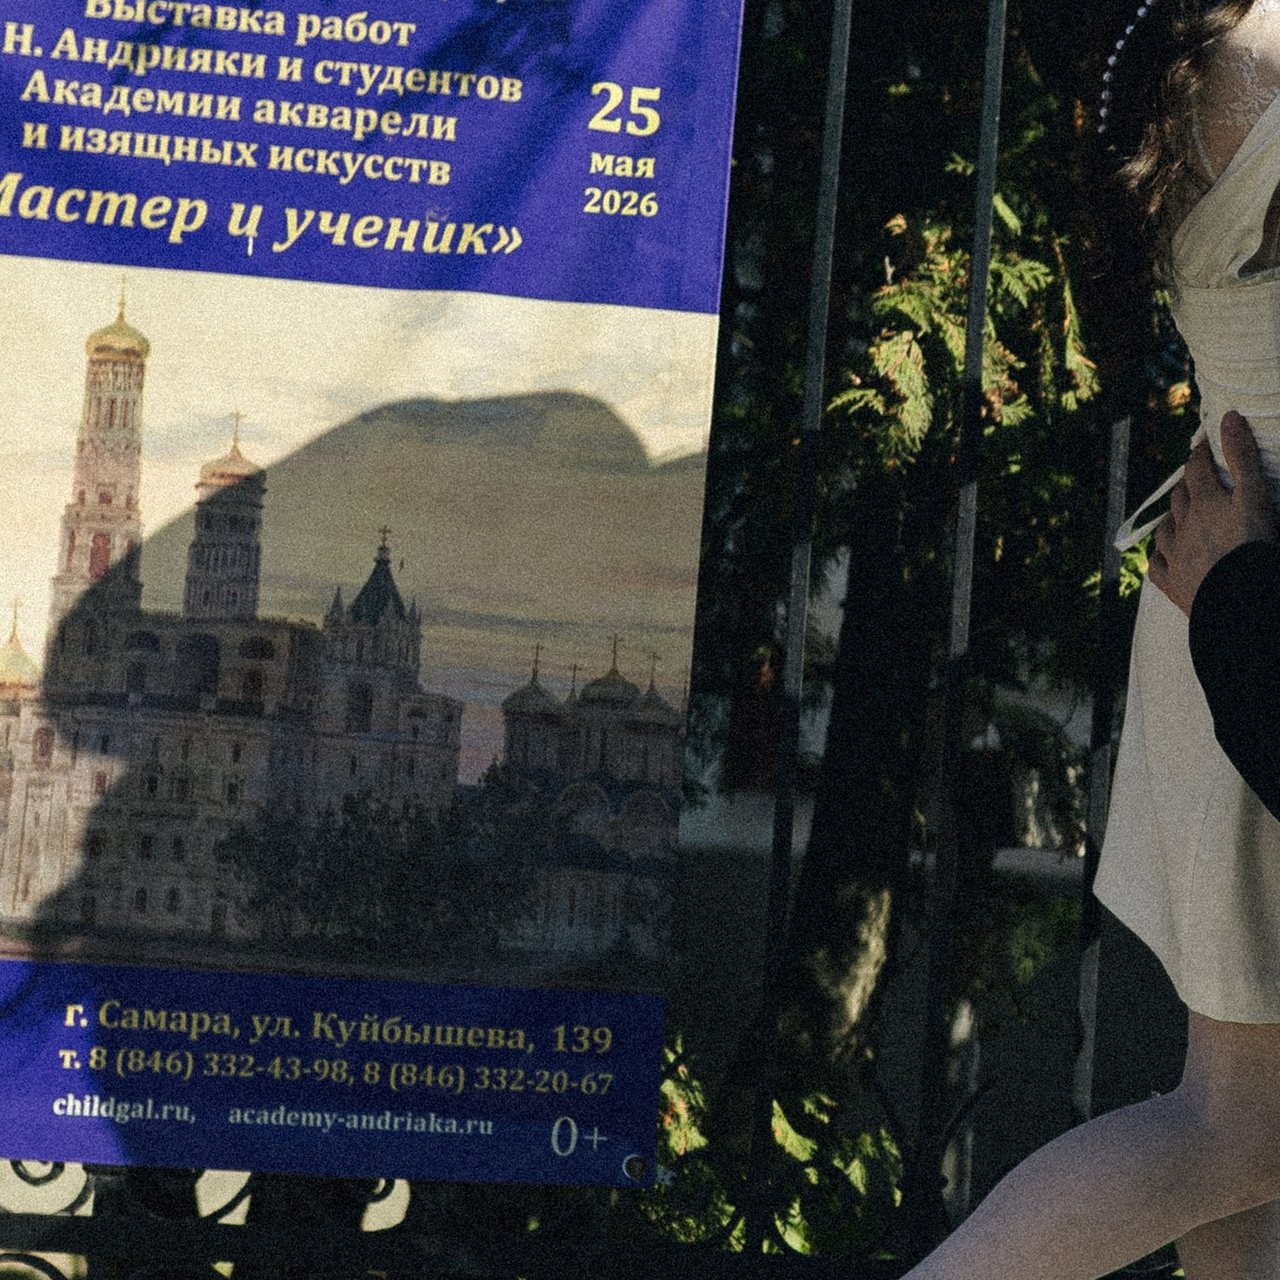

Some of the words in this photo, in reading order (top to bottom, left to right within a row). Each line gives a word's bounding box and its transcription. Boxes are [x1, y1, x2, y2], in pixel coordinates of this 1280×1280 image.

[295, 11, 416, 47] работ
[2, 22, 43, 56] Н.
[51, 28, 266, 80] Андрияки
[277, 53, 302, 80] и
[313, 56, 524, 103] студентов
[20, 70, 241, 121] Академии
[253, 98, 458, 143] акварели
[588, 82, 662, 138] 25
[21, 121, 47, 150] и
[59, 124, 257, 169] изящных
[268, 145, 452, 187] искусств
[589, 151, 656, 180] мая
[583, 187, 659, 218] 2026
[272, 205, 524, 255] ученик»
[64, 1003, 88, 1027] г.
[98, 1000, 240, 1041] Самара,
[249, 1014, 301, 1044] ул.
[312, 1011, 535, 1055] Куйбышева,
[552, 1024, 613, 1055] 139
[58, 1049, 81, 1070] т.
[88, 1046, 108, 1070] 8
[116, 1047, 194, 1080] (846)
[203, 1053, 355, 1086] 332-43-98,
[363, 1061, 381, 1084] 8
[389, 1062, 465, 1095] (846)
[474, 1066, 613, 1095] 332-20-67
[52, 1093, 196, 1124] childgal.ru,
[228, 1105, 493, 1136] academy-andriaka.ru
[550, 1116, 608, 1156] 0+
